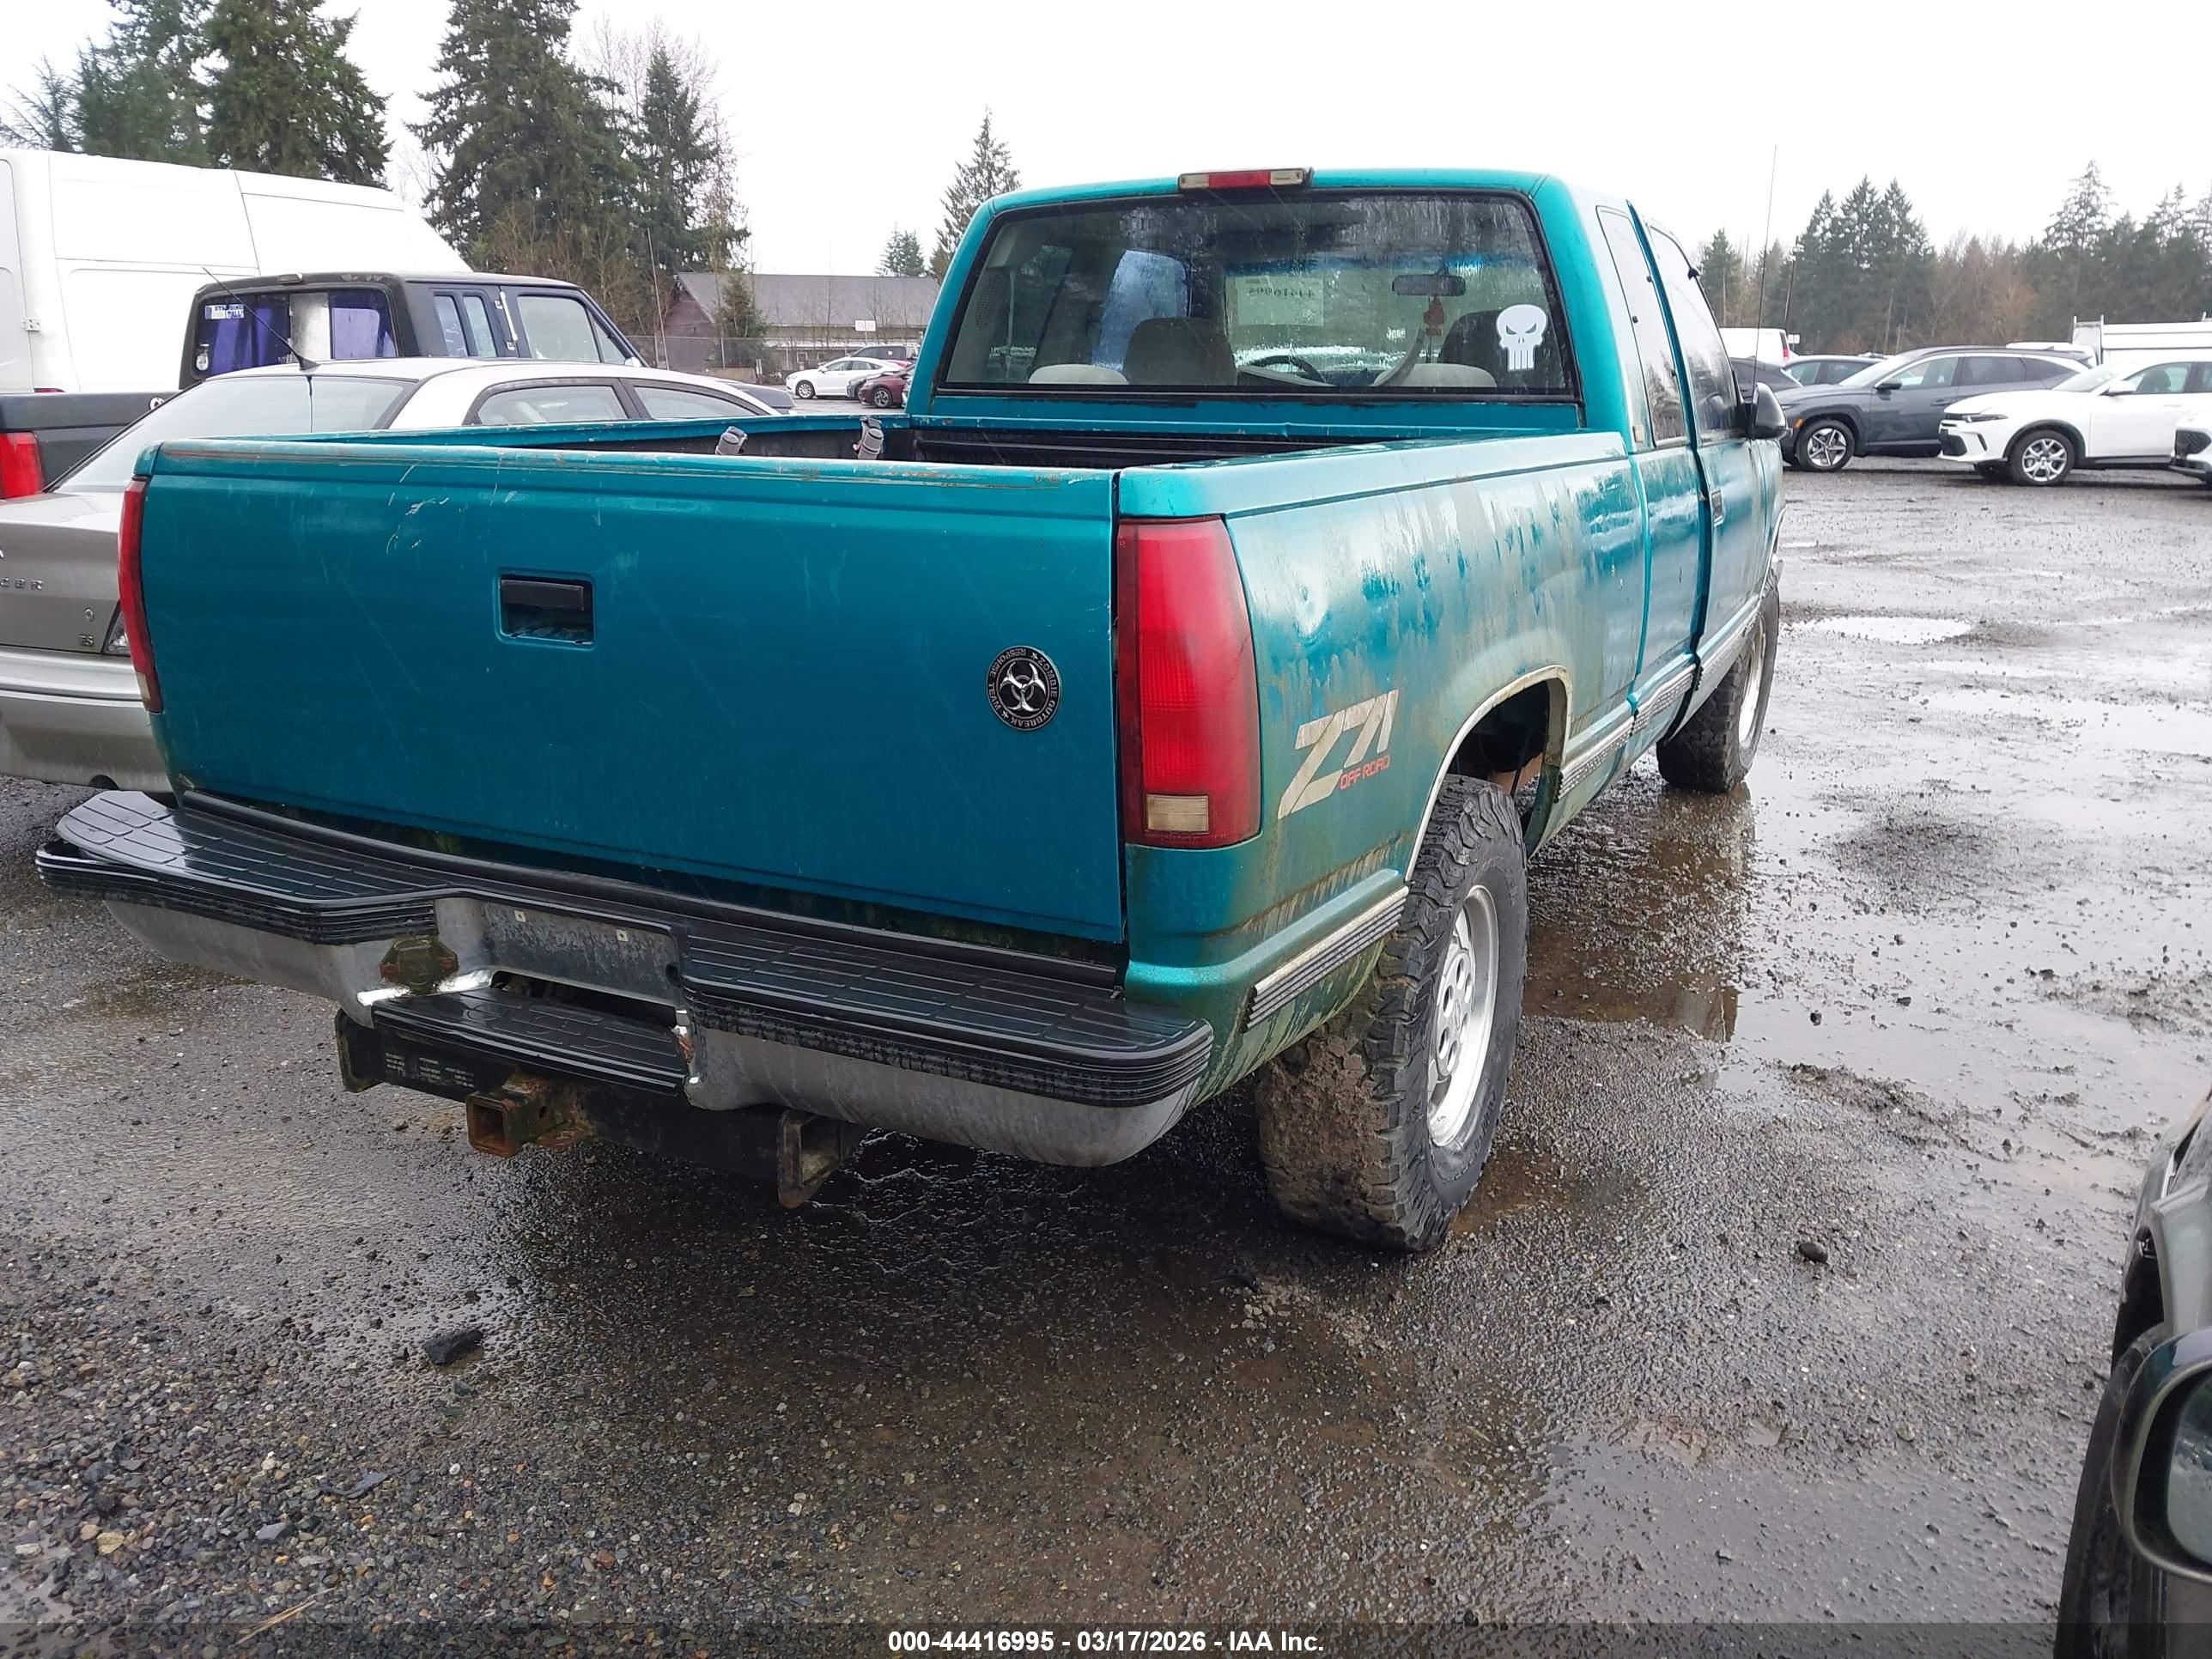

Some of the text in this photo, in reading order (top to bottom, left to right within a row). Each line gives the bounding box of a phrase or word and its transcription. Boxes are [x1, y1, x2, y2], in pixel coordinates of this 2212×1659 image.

[1037, 656, 1058, 697] ZOMBIE
[988, 682, 1002, 711] TEAM
[1011, 700, 1055, 727] OUTBREAK
[1278, 690, 1399, 819] Z71
[1340, 755, 1390, 790] OFF ROAD
